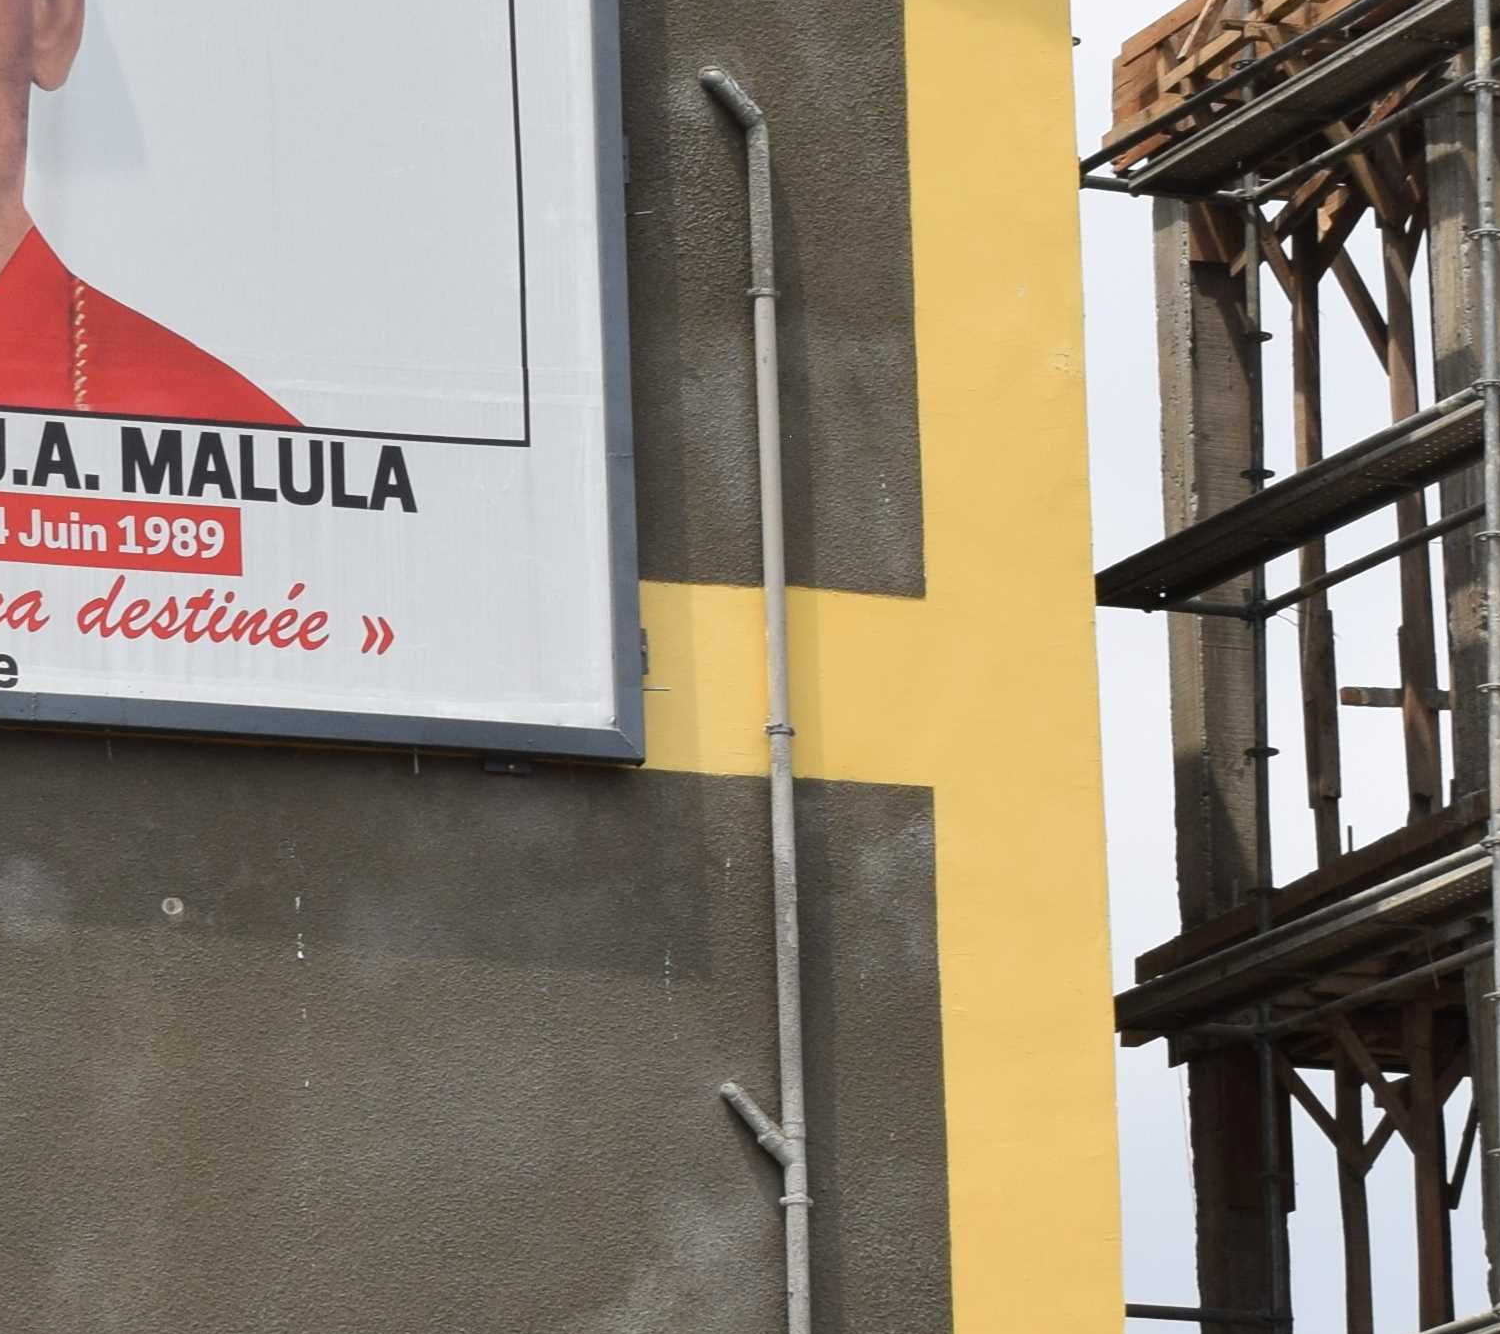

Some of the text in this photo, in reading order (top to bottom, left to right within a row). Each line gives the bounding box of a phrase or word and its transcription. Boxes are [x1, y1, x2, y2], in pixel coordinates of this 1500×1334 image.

[121, 426, 419, 514] MALULA
[18, 509, 108, 553] Juin
[117, 515, 226, 559] 1989
[75, 574, 331, 652] destinée
